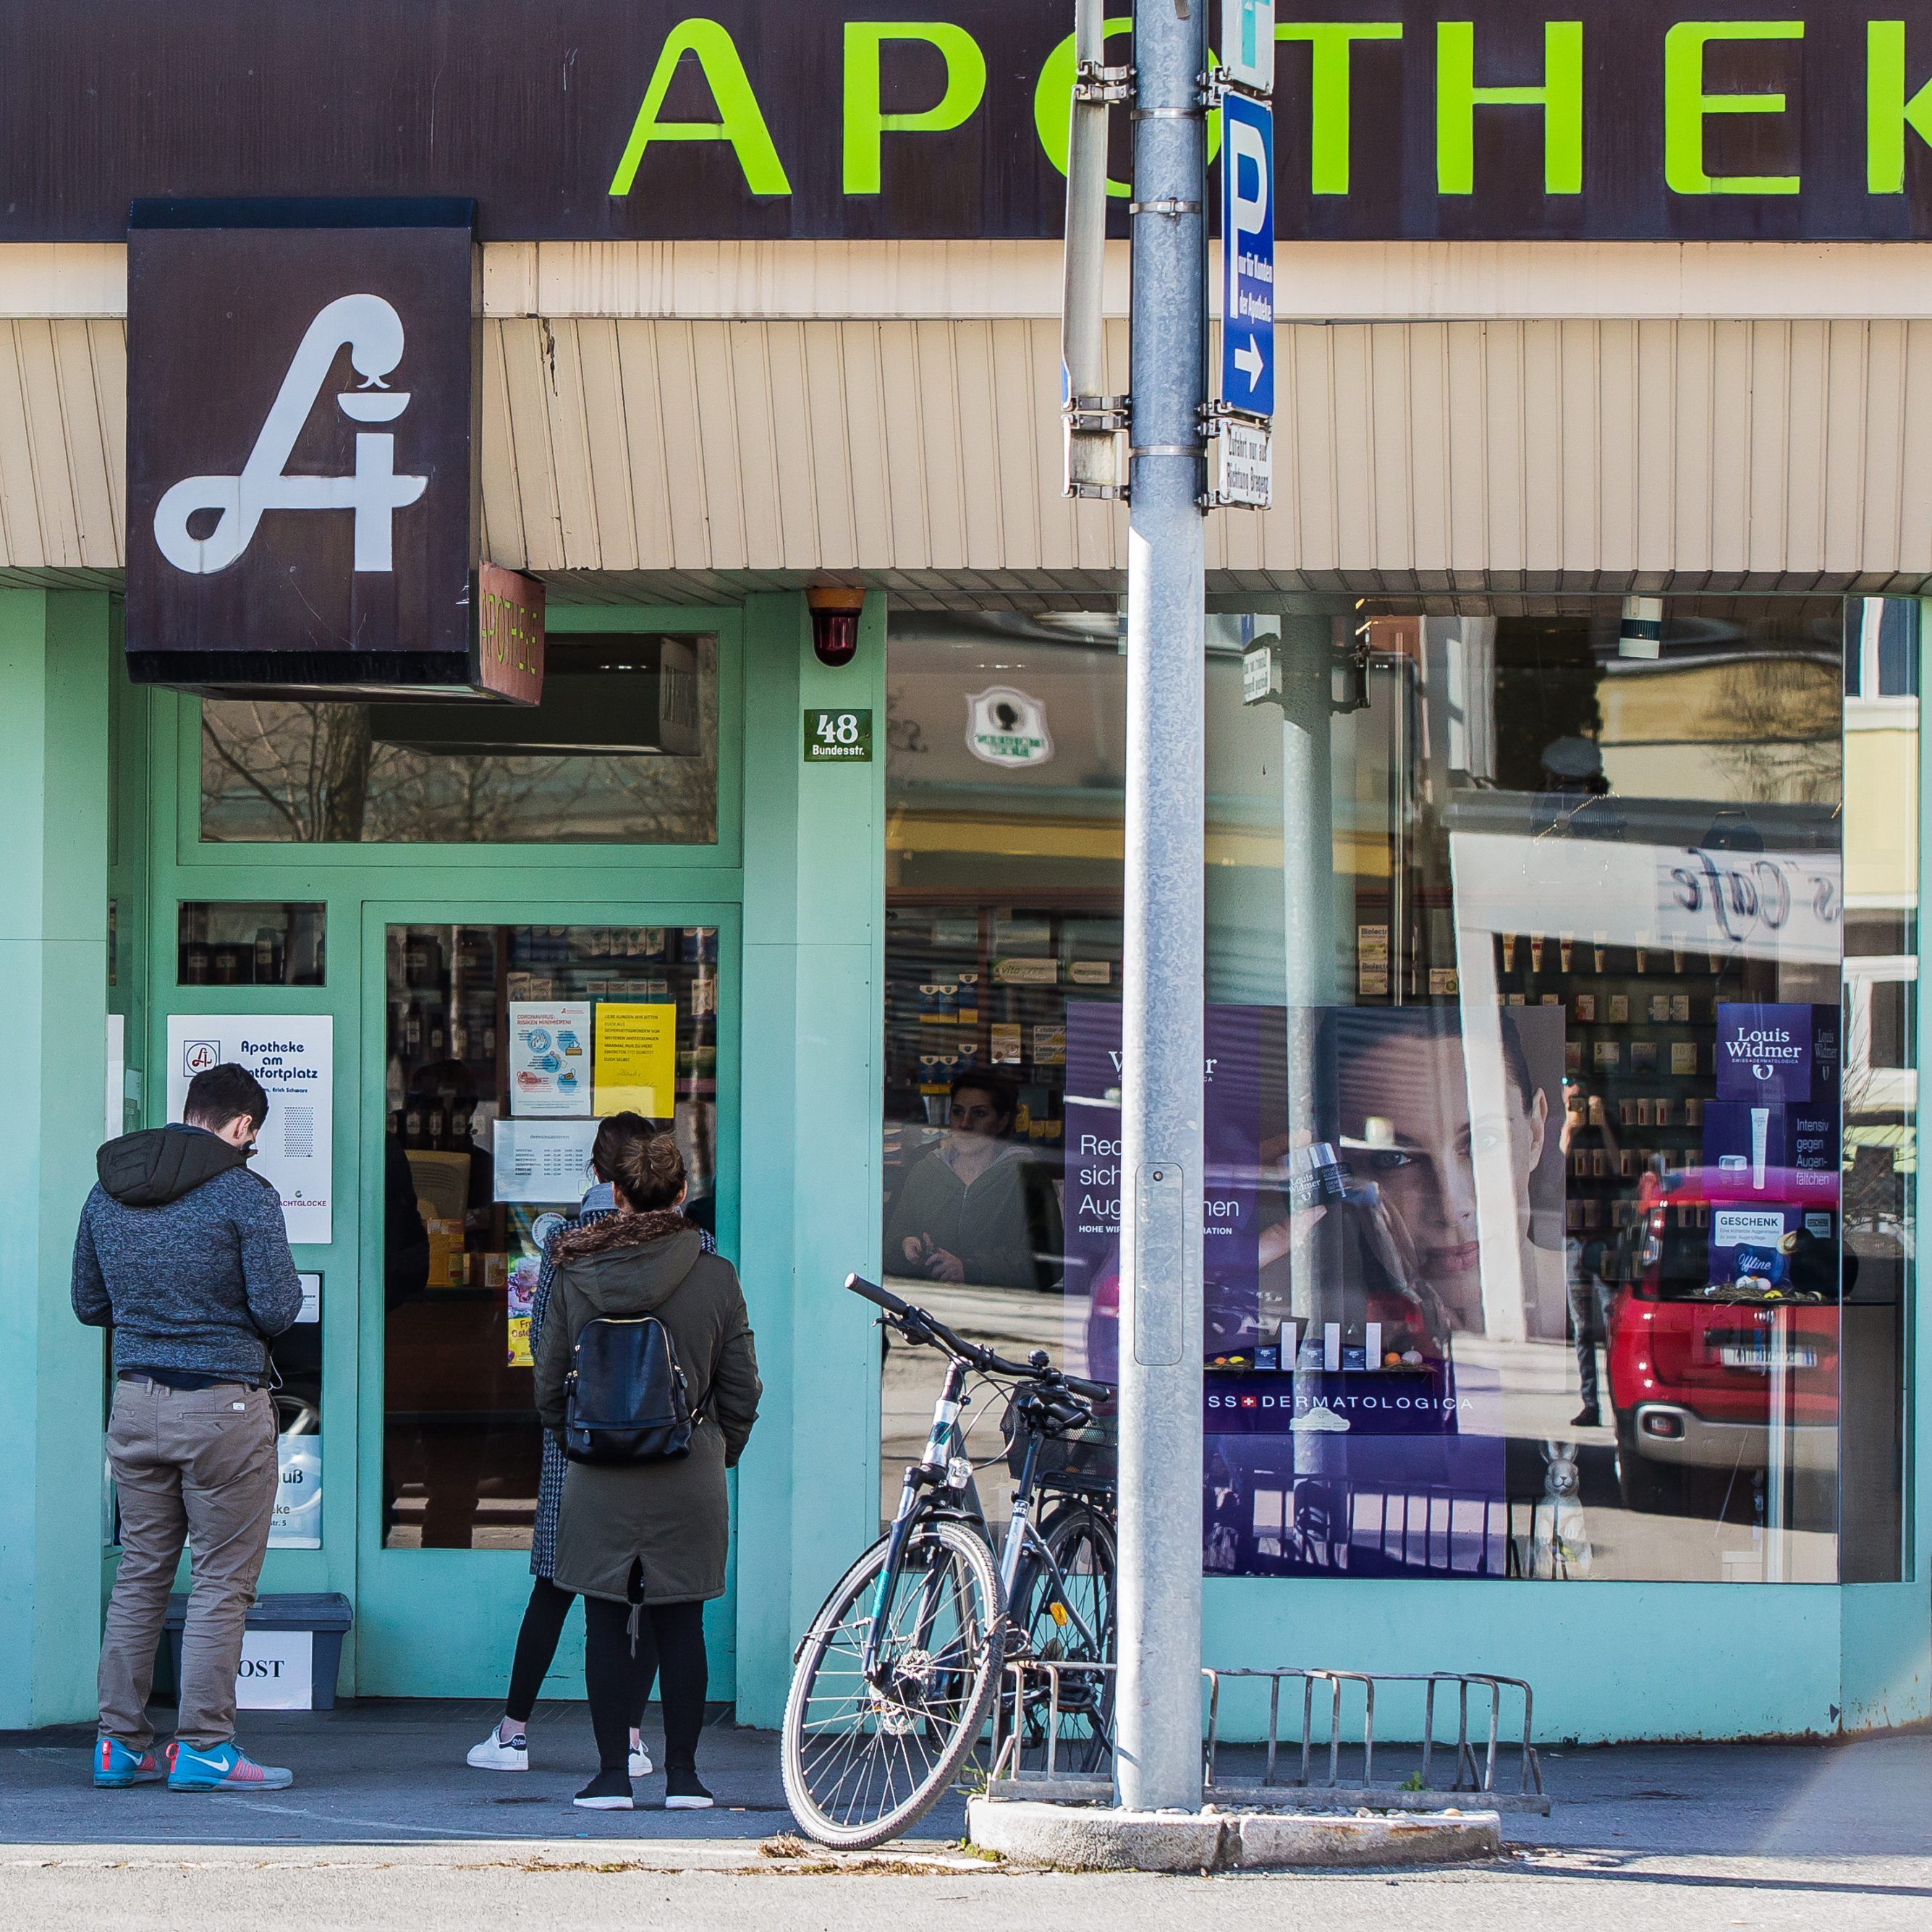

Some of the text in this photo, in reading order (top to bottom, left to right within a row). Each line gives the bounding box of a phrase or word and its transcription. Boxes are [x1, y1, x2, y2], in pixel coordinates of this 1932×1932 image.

[1230, 119, 1268, 319] P
[816, 714, 859, 744] 48
[813, 745, 865, 755] Bundesstr.
[1737, 1028, 1790, 1042] Louis
[241, 1041, 305, 1056] Apotheke
[1725, 1041, 1802, 1058] Widmer
[262, 1056, 283, 1065] am
[1797, 1118, 1829, 1132] Intensiv
[1797, 1138, 1823, 1153] gegen
[1796, 1154, 1828, 1170] Augen-
[1080, 1165, 1121, 1185] sich
[1291, 1173, 1314, 1187] Louis
[1796, 1172, 1830, 1185] fältchen
[1289, 1179, 1321, 1194] Widmer
[1720, 1216, 1779, 1226] GESCHENK
[1738, 1253, 1771, 1272] Offline
[512, 1329, 531, 1338] Oste
[1208, 1396, 1474, 1410] SS DERMATOLOGICA
[237, 1659, 285, 1678] OST
